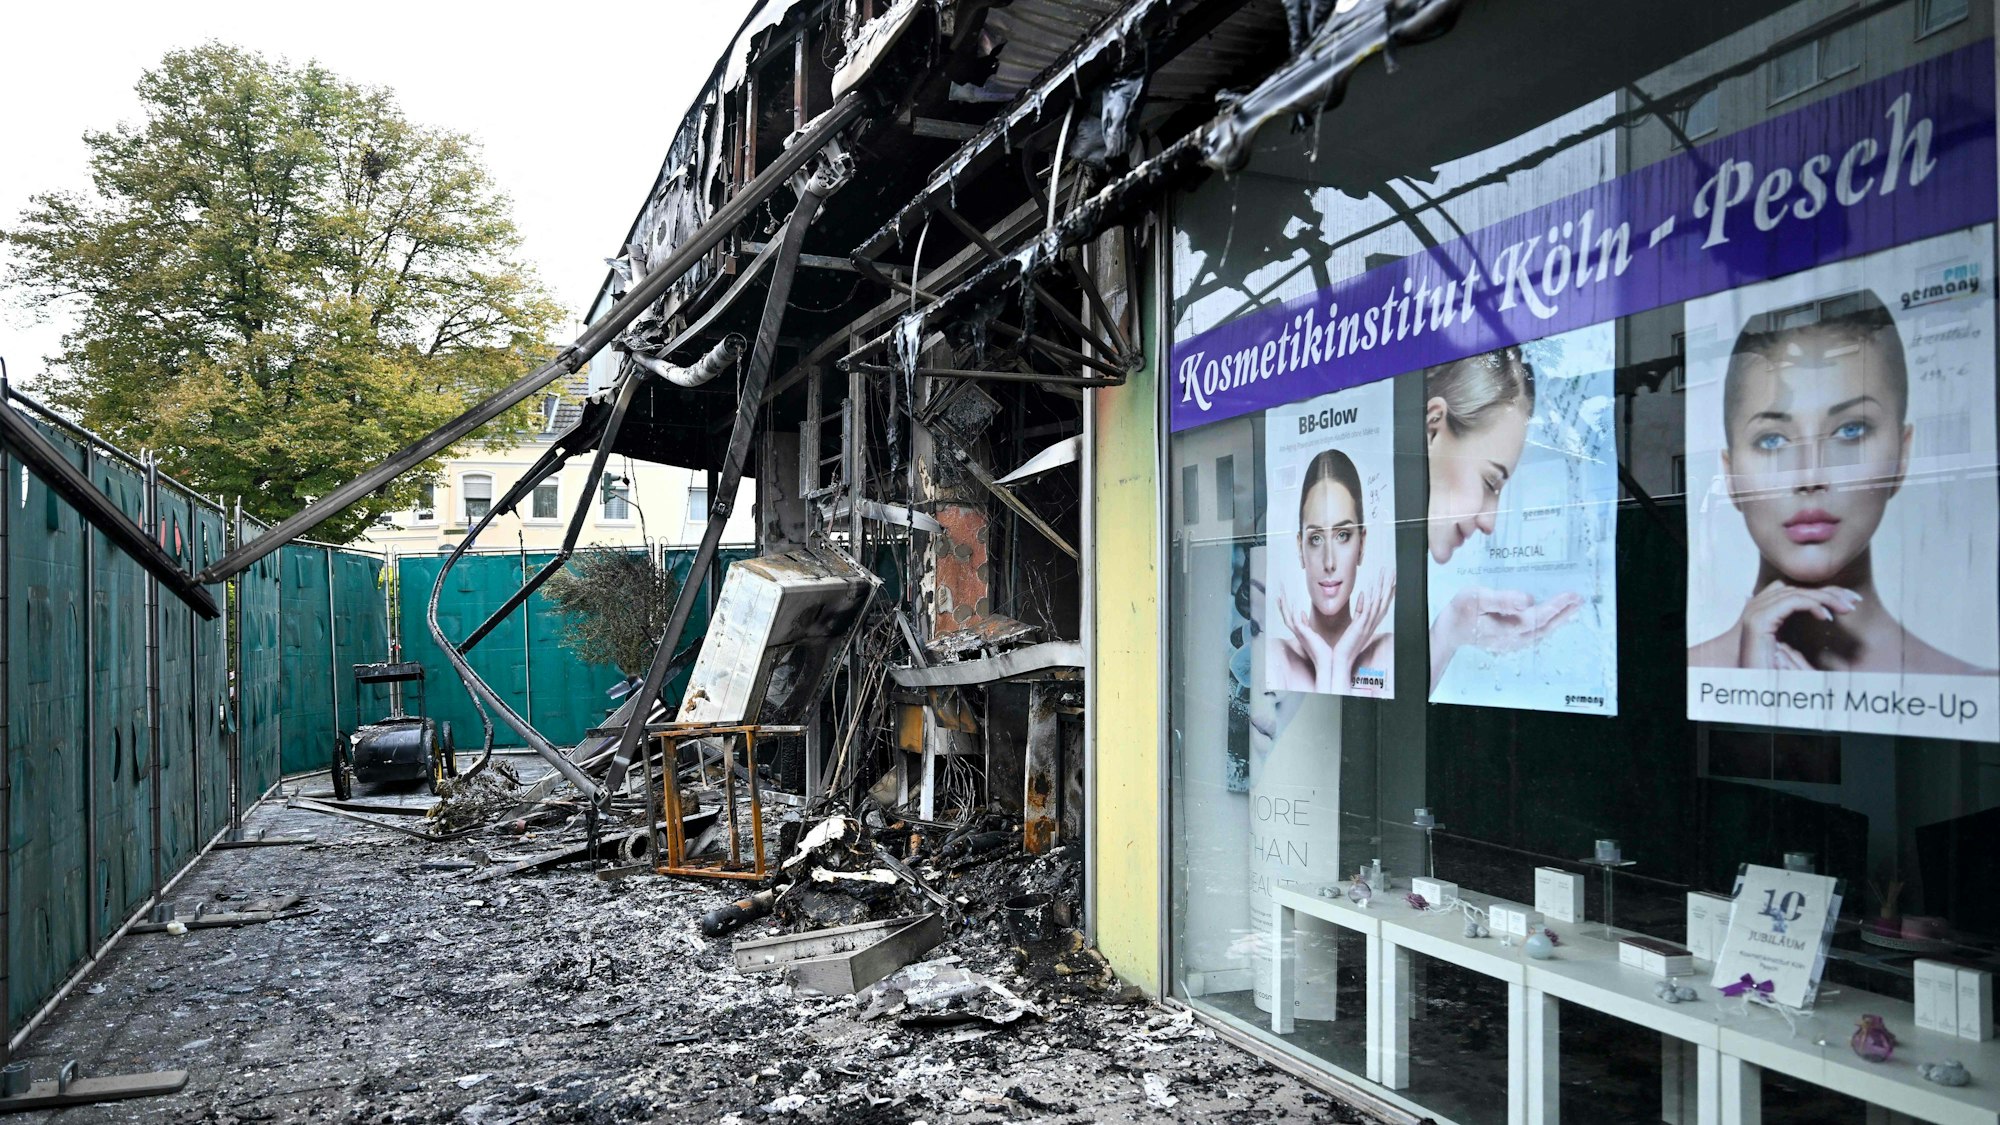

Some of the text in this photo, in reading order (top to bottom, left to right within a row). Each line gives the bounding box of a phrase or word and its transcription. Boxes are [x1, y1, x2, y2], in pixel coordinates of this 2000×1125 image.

[1179, 259, 1480, 412] Kosmetikinstitut
[1492, 209, 1633, 319] Köln
[1694, 92, 1938, 250] Pesch
[1901, 276, 1979, 307] germany
[1299, 408, 1358, 435] BB-Glow
[1489, 546, 1545, 559] PRO-FACIAL
[1352, 677, 1384, 688] germany
[1565, 695, 1604, 707] germany
[1700, 683, 1978, 724] Permanent Make-Up
[1254, 795, 1310, 826] ORE
[1758, 889, 1806, 922] 10
[1748, 930, 1806, 951] JUBILÄUM
